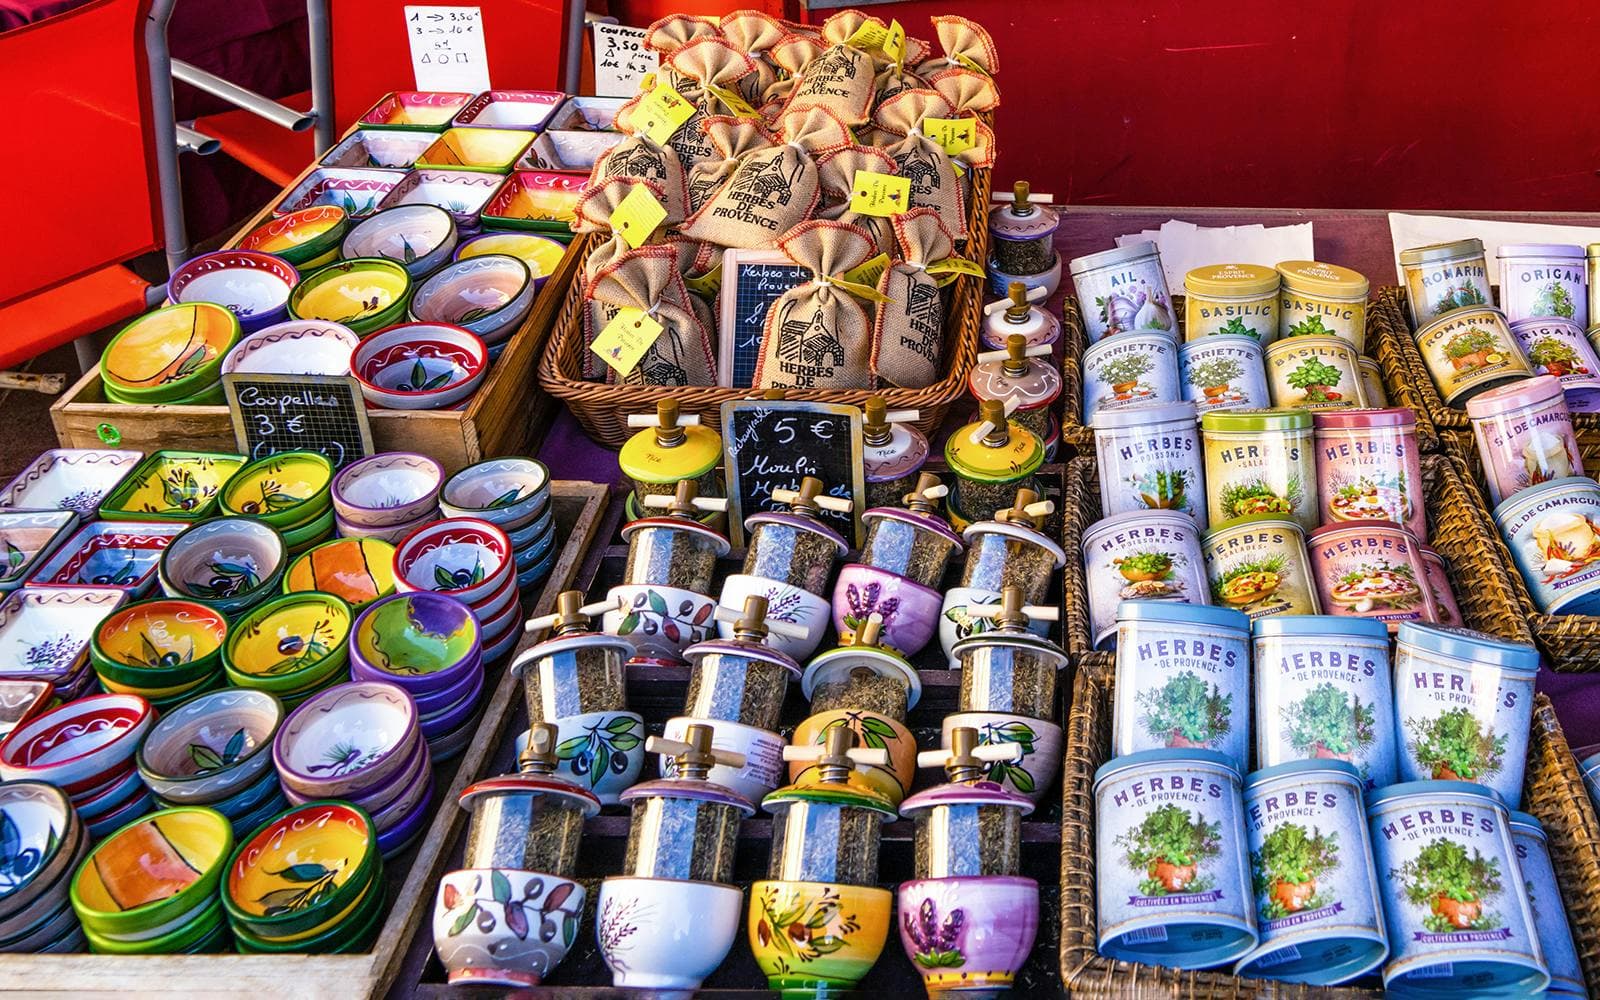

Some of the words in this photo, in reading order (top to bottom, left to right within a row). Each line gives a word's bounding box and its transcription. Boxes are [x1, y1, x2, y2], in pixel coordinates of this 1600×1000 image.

[410, 12, 419, 21] 1
[416, 27, 423, 35] 3
[678, 153, 694, 164] DE
[909, 185, 933, 195] BES
[727, 190, 776, 210] HERBES
[736, 201, 753, 213] DE
[712, 207, 779, 231] PROVENCE
[1111, 271, 1137, 288] AIL
[1421, 265, 1485, 288] ROMARIN
[1521, 268, 1582, 285] ORIGAN
[1200, 305, 1271, 319] BASILIC
[1283, 299, 1353, 320] BASILIC
[1425, 317, 1495, 348] ROMARIN
[1520, 328, 1578, 341] RIGAN
[1087, 343, 1168, 371] SARRIETTE
[1182, 348, 1255, 368] ARRIETTE
[1275, 348, 1349, 367] BASILIC
[780, 361, 834, 378] HERBES
[796, 375, 816, 388] DE
[254, 414, 275, 435] 3
[286, 414, 305, 433] €
[774, 417, 798, 444] 5
[810, 420, 834, 439] €
[1494, 431, 1514, 447] SL
[1514, 422, 1529, 435] DE
[1120, 437, 1193, 460] HERBES
[1140, 450, 1180, 463] POISSONS
[1325, 441, 1405, 460] HERBES
[742, 455, 817, 476] Moulin
[1351, 457, 1381, 466] PIZZA
[1507, 523, 1524, 541] SEL
[1521, 509, 1537, 522] DE
[1101, 527, 1185, 552] HERBES
[1121, 537, 1167, 550] POISSONS
[1322, 538, 1408, 560] HERBES
[1350, 549, 1383, 558] PIZZA
[1137, 639, 1237, 668] HERBES
[1159, 659, 1170, 668] DE
[1174, 658, 1217, 673] PROVENCE
[1297, 671, 1309, 681] DE
[1311, 669, 1356, 683] PROVENCE
[1434, 692, 1446, 702] DE
[1114, 776, 1222, 807] HERBES
[1137, 798, 1149, 807] DE
[1151, 792, 1199, 804] PROVENCE
[1249, 791, 1337, 822] ERBES
[1268, 807, 1314, 823] PROVENCE
[1382, 809, 1494, 840] HERBES
[1408, 830, 1419, 840] DE
[1424, 826, 1473, 838] PROVENCE
[1171, 897, 1179, 905] EN
[1181, 894, 1214, 904] PROVENCE
[1302, 910, 1334, 923] PROVENCE
[1459, 934, 1469, 942] EN
[1470, 931, 1503, 942] PROVENCE
